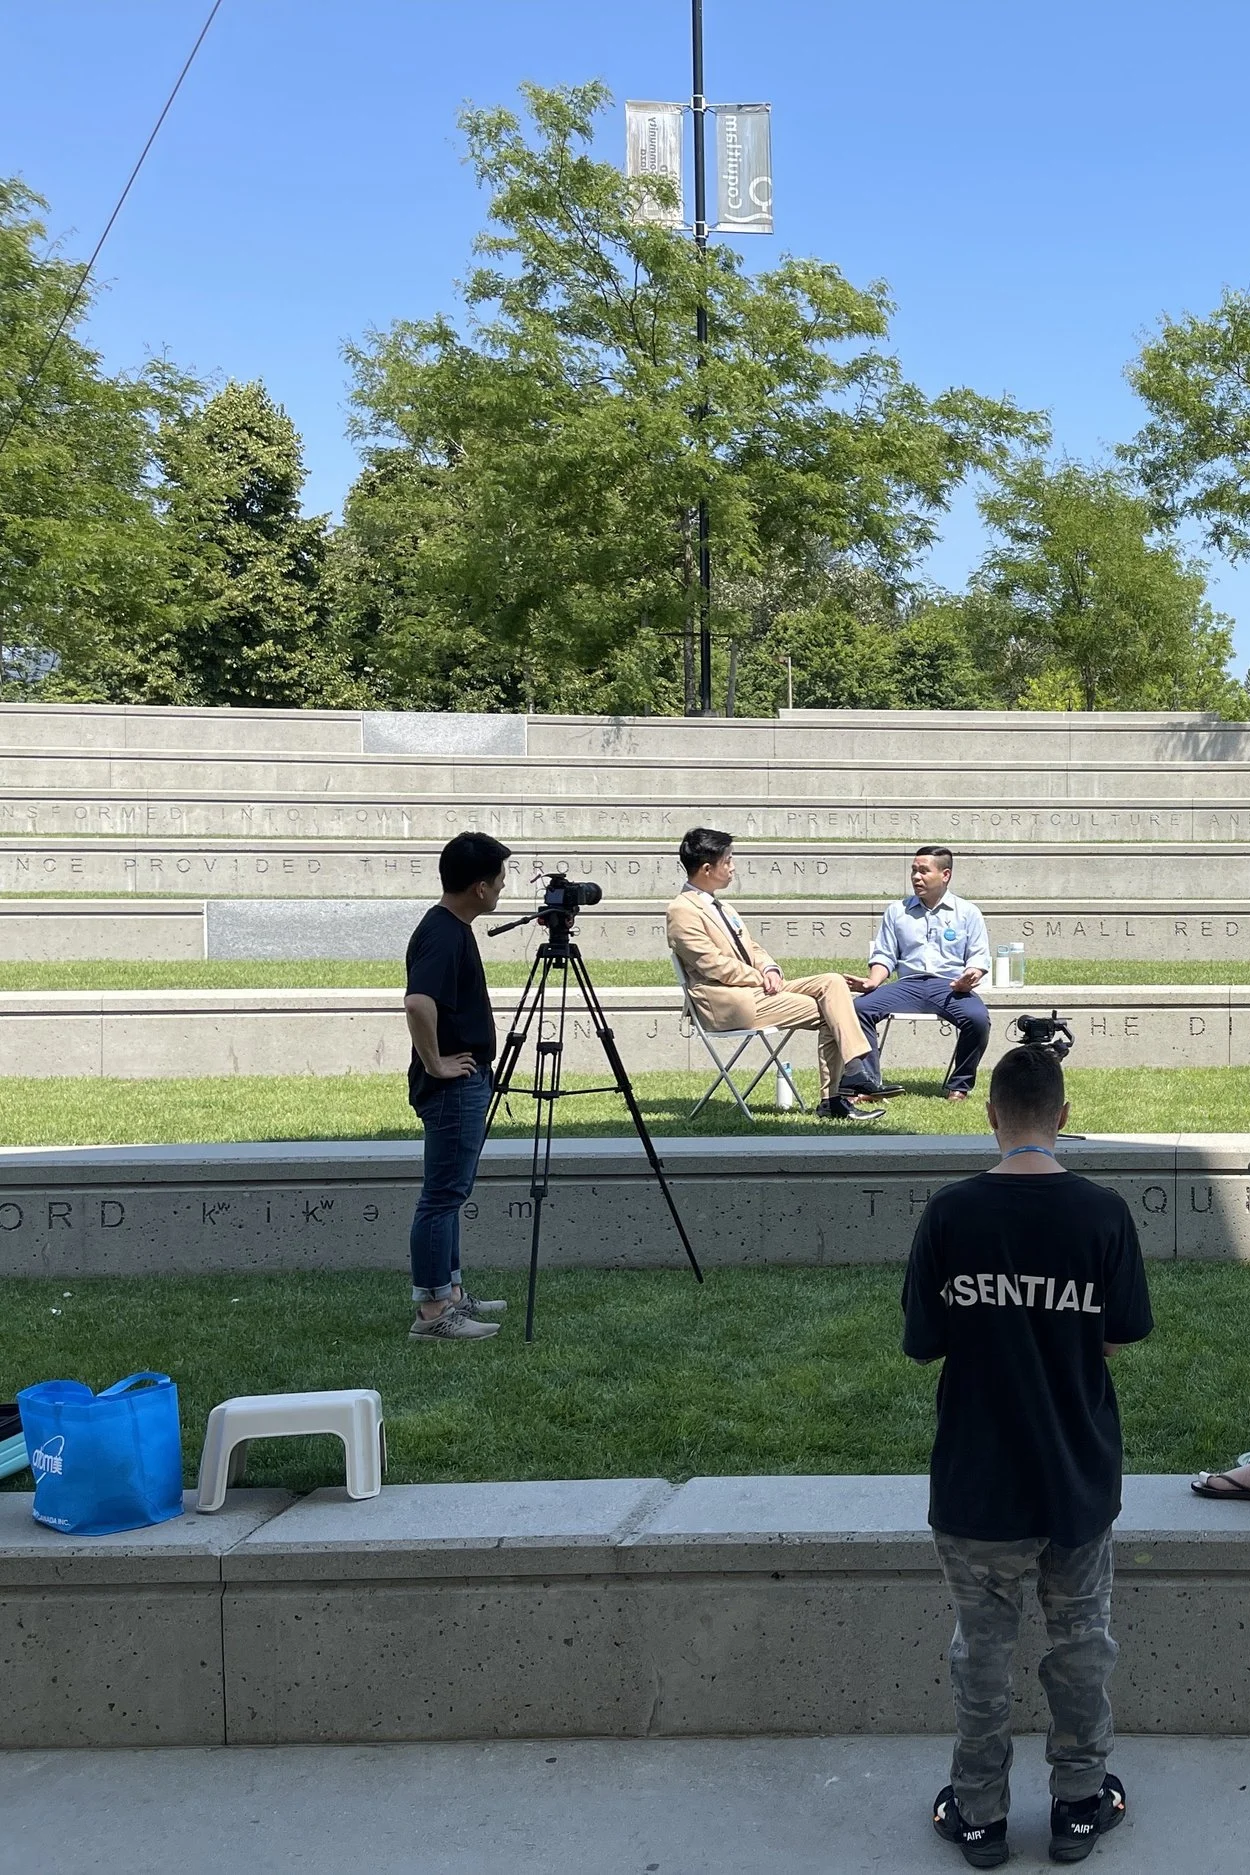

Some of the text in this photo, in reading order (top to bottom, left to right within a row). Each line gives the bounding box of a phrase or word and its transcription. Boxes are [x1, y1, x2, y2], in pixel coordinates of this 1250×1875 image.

[221, 806, 300, 821] INTO
[333, 808, 412, 823] TOWN
[445, 809, 565, 824] CENTRE
[597, 811, 673, 824] PARK
[745, 812, 757, 825] A
[787, 812, 921, 826] PREMIER
[124, 858, 321, 874] PROVIDED
[359, 859, 421, 875] THE
[747, 861, 829, 876] LAND
[760, 921, 852, 938] FERS
[1021, 921, 1136, 938] SMALL
[1174, 921, 1240, 937] RED
[862, 1189, 930, 1216] TH
